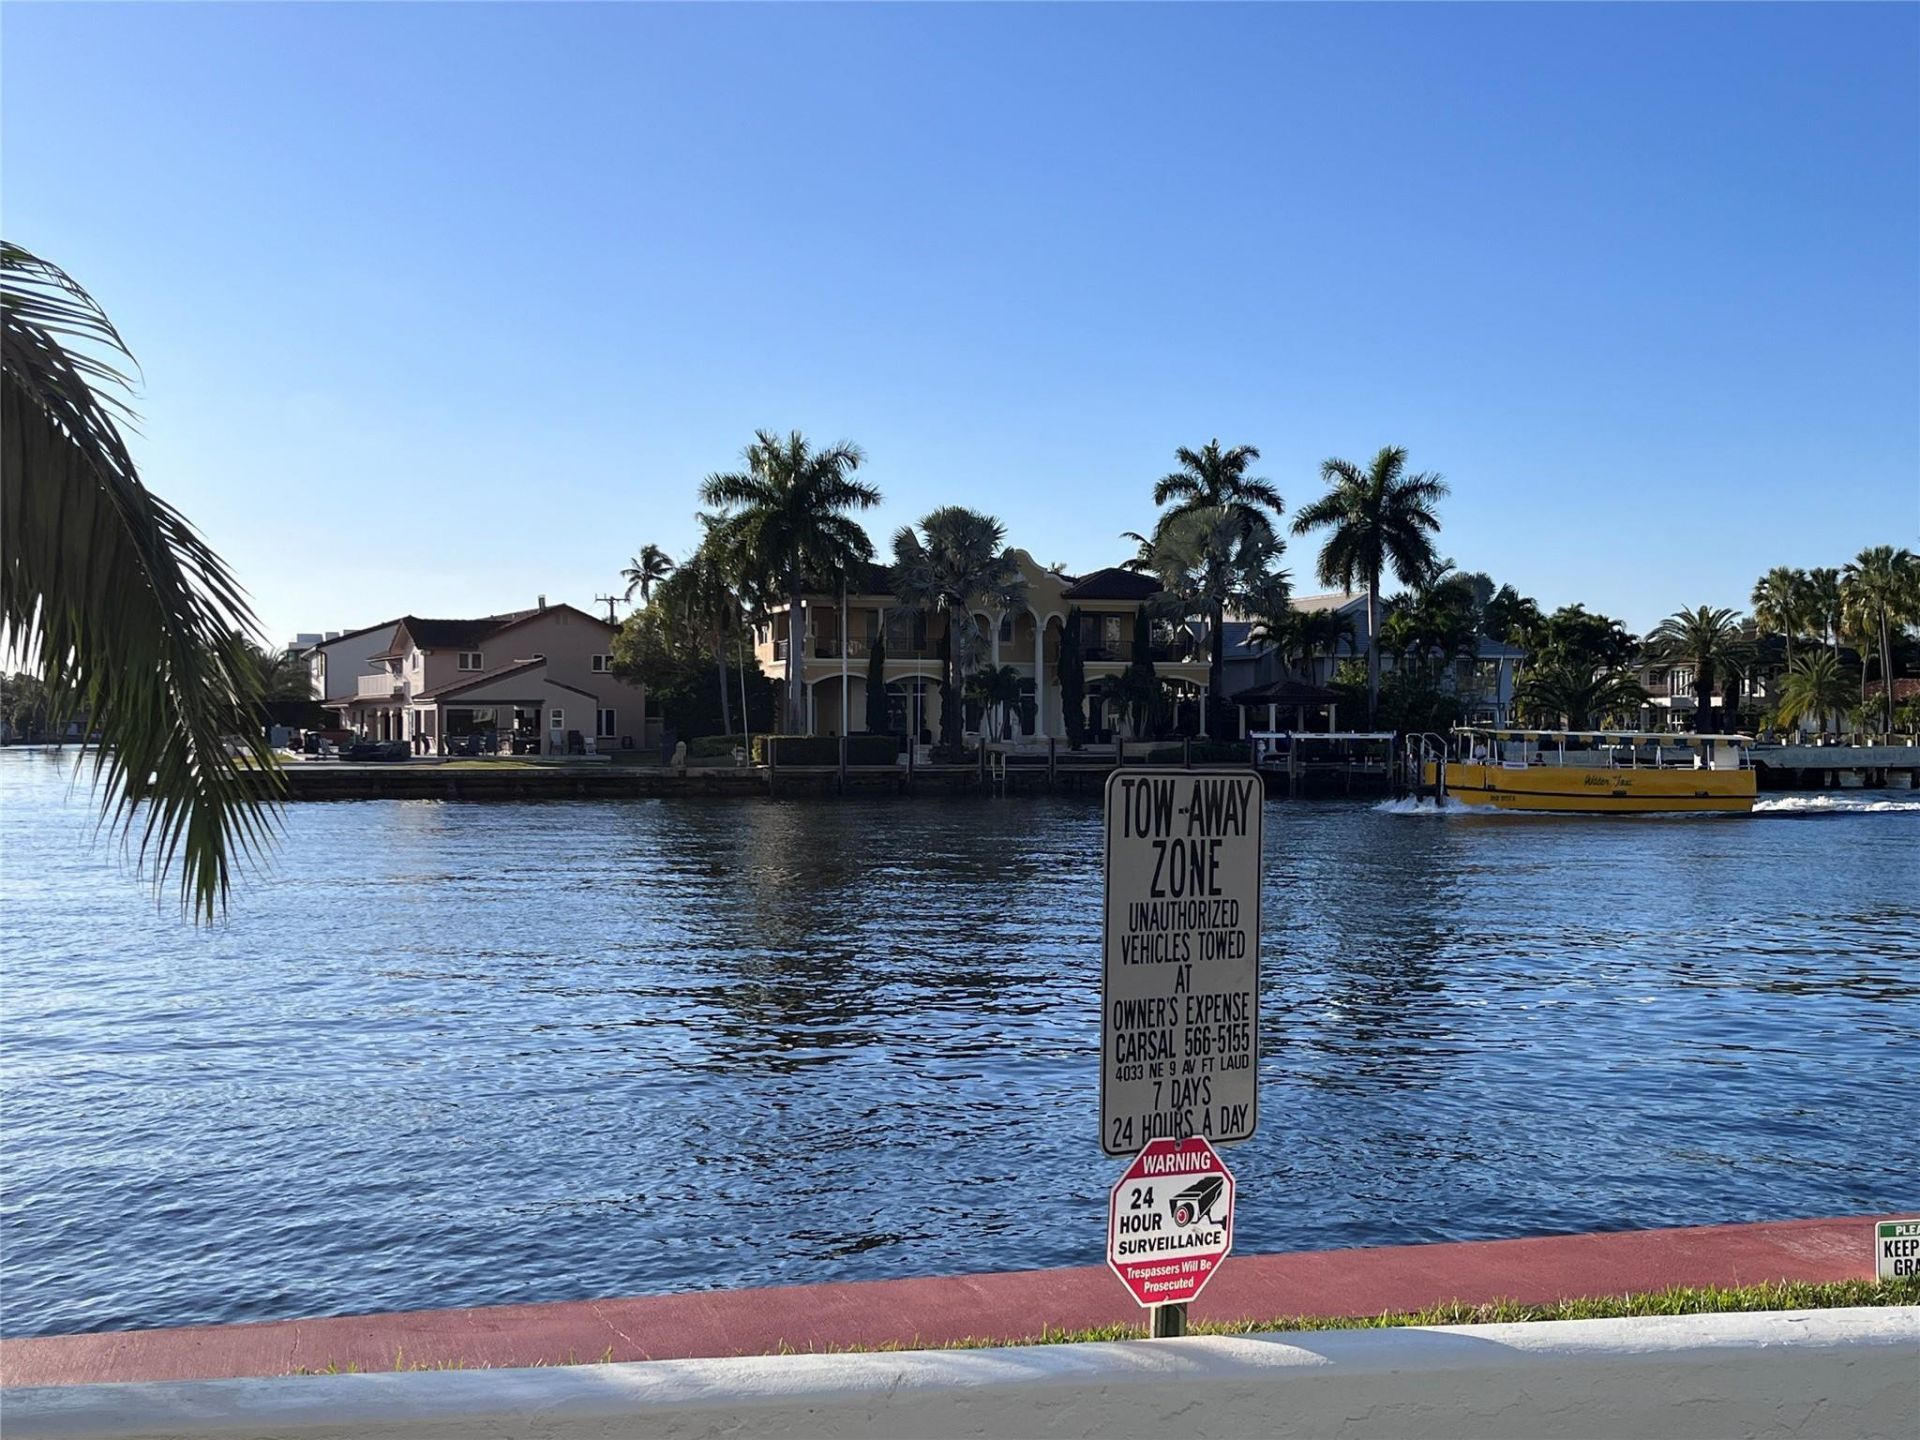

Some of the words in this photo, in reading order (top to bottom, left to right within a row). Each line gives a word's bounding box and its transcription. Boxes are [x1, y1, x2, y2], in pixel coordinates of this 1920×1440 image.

[1150, 838, 1223, 898] ZONE
[1129, 899, 1239, 932] UNAUTHORIZED
[1122, 932, 1190, 965] VEHICLES
[1198, 930, 1245, 961] TOWED
[1174, 964, 1192, 994] AT
[1114, 996, 1179, 1031] OWNER'S
[1186, 992, 1250, 1026] EXPENSE
[1116, 1030, 1176, 1063] CARSAL
[1185, 1023, 1250, 1057] 566-5155
[1116, 1062, 1144, 1082] 4033
[1149, 1062, 1166, 1078] NE
[1170, 1060, 1176, 1075] 9
[1182, 1058, 1196, 1075] AV
[1202, 1057, 1215, 1072] FT
[1220, 1054, 1249, 1071] LAUD
[1153, 1081, 1162, 1110] 7
[1171, 1076, 1211, 1109] DAYS
[1113, 1117, 1132, 1148] 24
[1142, 1109, 1193, 1143] HOURS
[1202, 1108, 1212, 1136] A
[1221, 1103, 1248, 1134] DAY
[1143, 1151, 1211, 1174] WARNING
[1131, 1186, 1154, 1210] 24
[1120, 1213, 1162, 1234] HOUR
[1119, 1231, 1221, 1255] SURVEILLANCE
[1884, 1240, 1919, 1257] KEEP
[1127, 1265, 1180, 1280] Trespassers
[1182, 1261, 1199, 1273] Will
[1200, 1259, 1212, 1271] Be
[1144, 1276, 1194, 1293] Prosecuted
